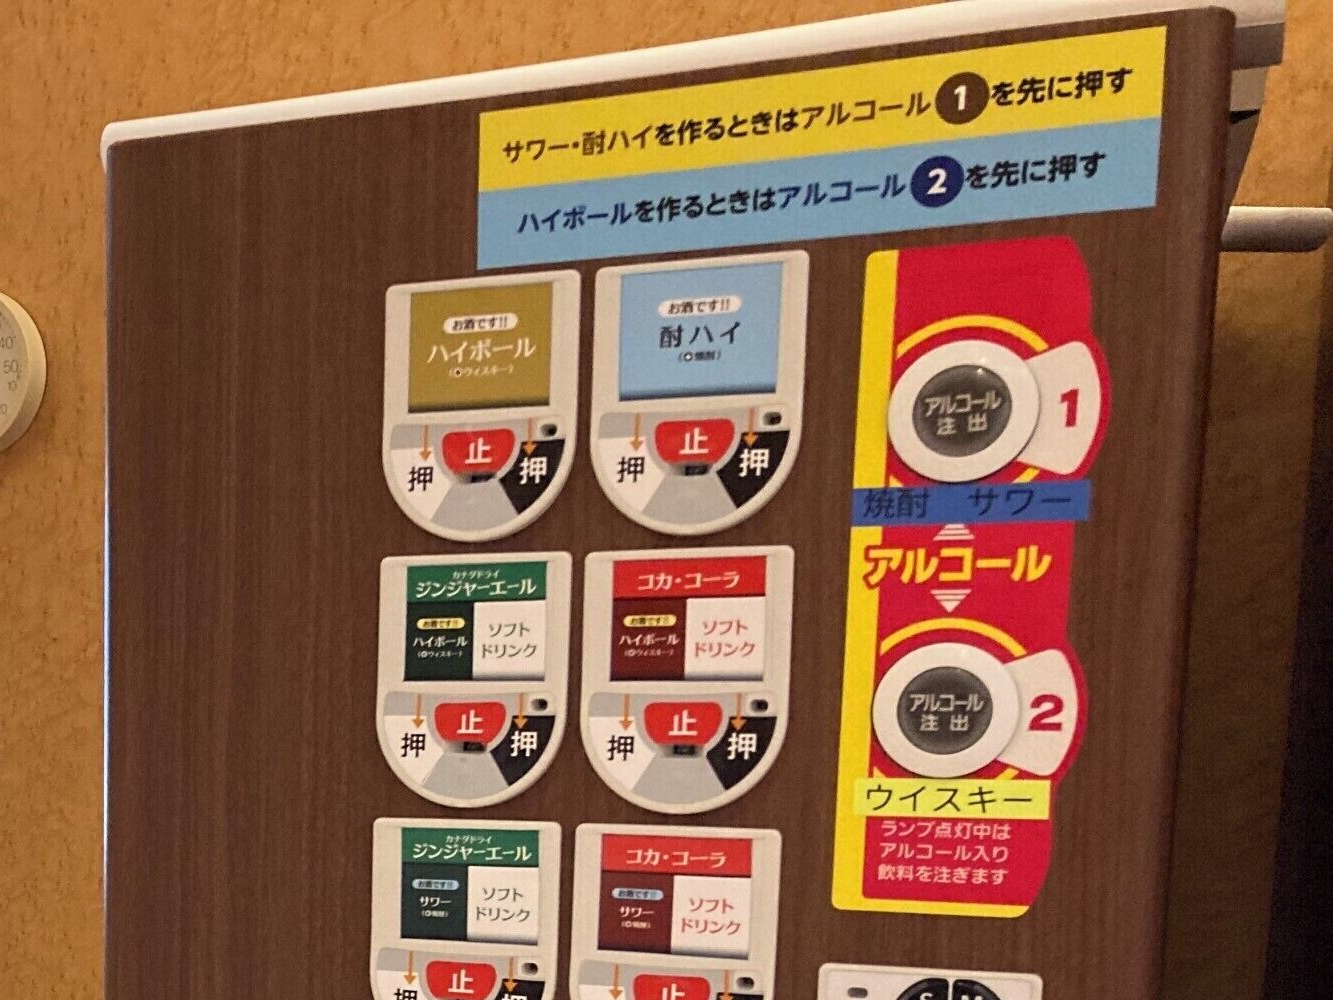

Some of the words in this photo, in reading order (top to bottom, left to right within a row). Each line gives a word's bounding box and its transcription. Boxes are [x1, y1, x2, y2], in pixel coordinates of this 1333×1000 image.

[659, 321, 741, 348] 酎ハイ
[427, 337, 537, 363] ハイボール
[924, 388, 1002, 417] アルコール
[1060, 388, 1079, 428] 1
[464, 439, 491, 465] 止
[679, 428, 708, 456] 止
[519, 457, 547, 485] 押
[617, 455, 645, 483] 押
[738, 448, 769, 477] 押
[408, 465, 434, 492] 押
[862, 488, 929, 519] 焼酎
[968, 487, 1072, 516] サワー
[865, 544, 1054, 587] アルコール
[415, 578, 537, 598] ジンジャーエール
[637, 571, 740, 591] コカ・コーラ
[489, 623, 530, 637] ソフト
[702, 619, 749, 635] ソフト
[412, 635, 467, 648] ハイボール
[482, 643, 537, 658] ドリンク
[619, 633, 680, 646] ハイボール
[694, 641, 756, 658] ドリンク
[909, 691, 984, 714] アルコール
[1027, 694, 1065, 732] 2
[457, 710, 484, 734] 止
[668, 710, 698, 736] 止
[400, 732, 426, 759] 押
[510, 730, 538, 758] 押
[607, 733, 635, 761] 押
[727, 732, 756, 760] 押
[865, 783, 1034, 815] ウイスキー
[879, 819, 1011, 840] ランプ点灯中は
[412, 842, 532, 861] ジンジャーエール
[626, 848, 726, 868] コカ・コーラ
[879, 842, 1010, 863] アルコール入り
[877, 863, 1009, 886] 飲料を注ぎます
[419, 896, 452, 907] サワー
[483, 887, 523, 901] ソフト
[689, 898, 734, 913] ソフト
[476, 906, 530, 922] ドリンク
[619, 906, 654, 918] サワー
[681, 918, 741, 935] ドリンク
[448, 970, 474, 995] 止
